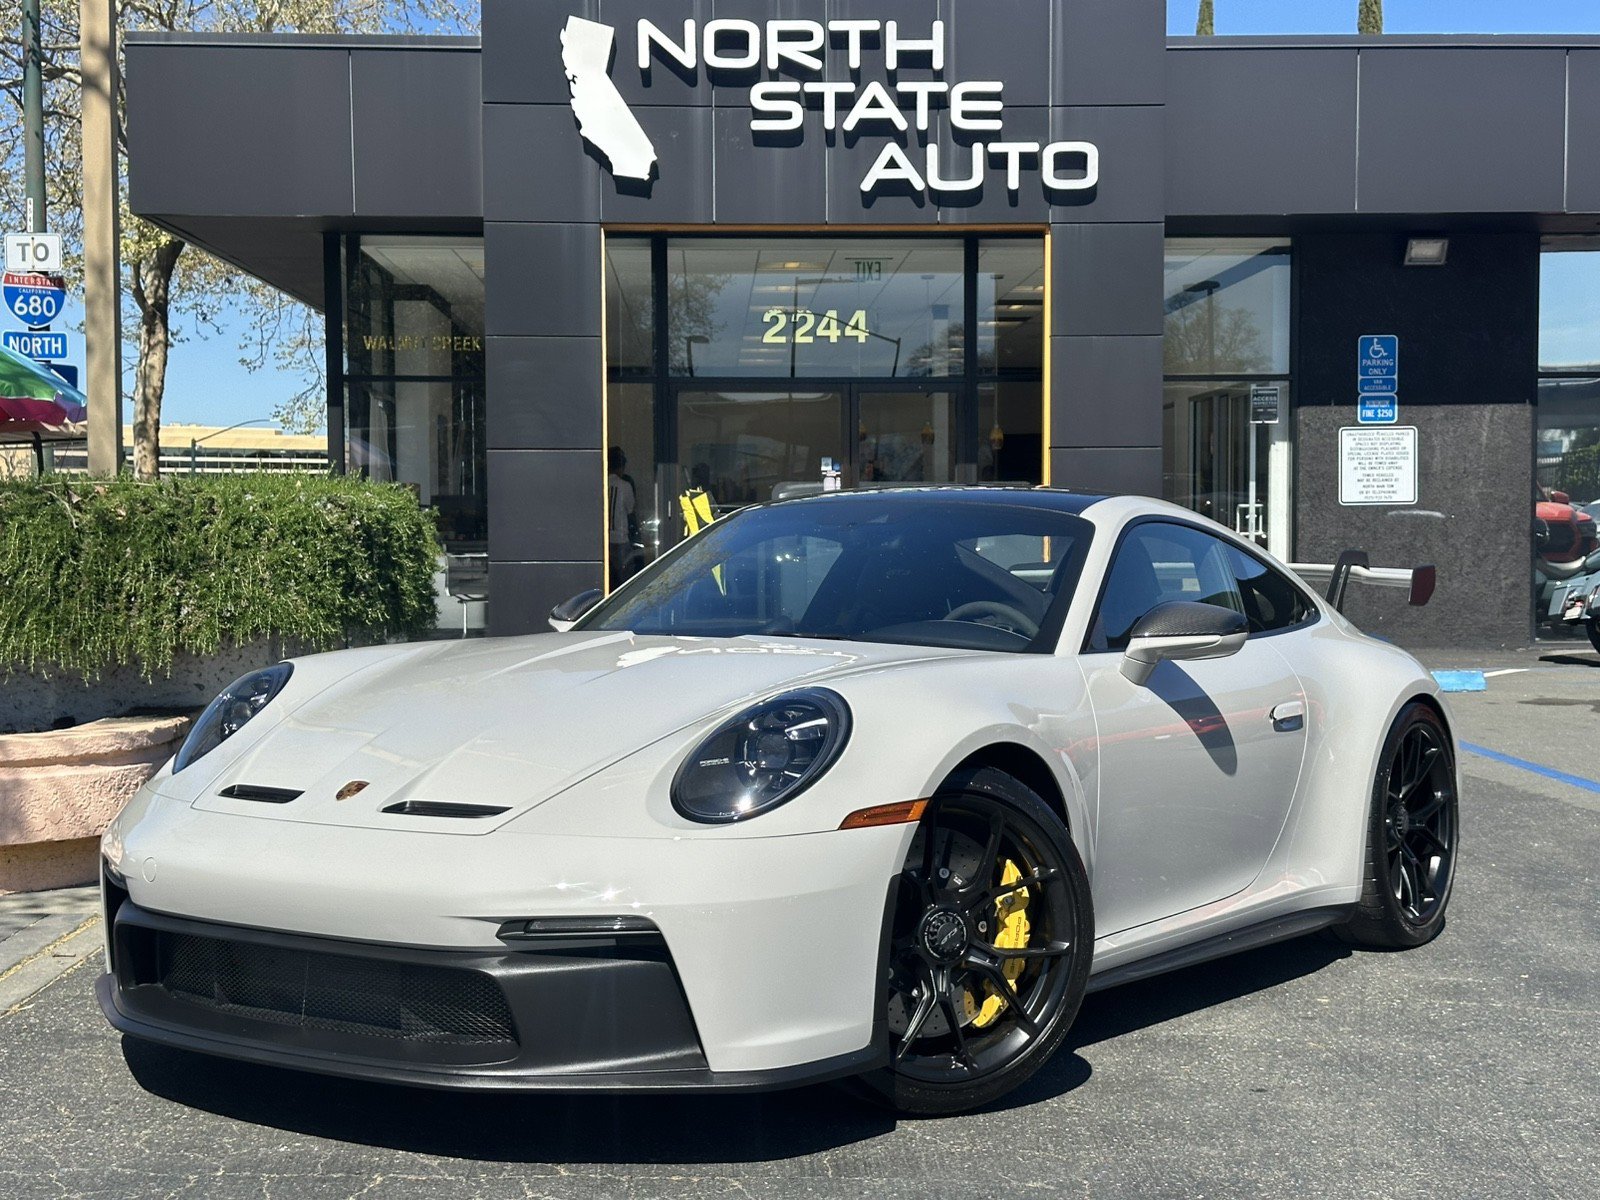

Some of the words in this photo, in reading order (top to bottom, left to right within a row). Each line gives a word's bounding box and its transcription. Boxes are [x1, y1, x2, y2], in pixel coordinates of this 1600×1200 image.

[637, 19, 944, 70] NORTH
[750, 81, 1004, 131] STATE
[860, 142, 1099, 191] AUTO
[16, 242, 50, 262] TO
[18, 287, 52, 296] CALIFORNIA
[14, 294, 56, 317] 680
[762, 309, 870, 343] 2244
[9, 335, 62, 355] NORTH
[1368, 367, 1388, 375] ONLY
[1362, 409, 1375, 418] FINE
[1377, 408, 1394, 418] $250
